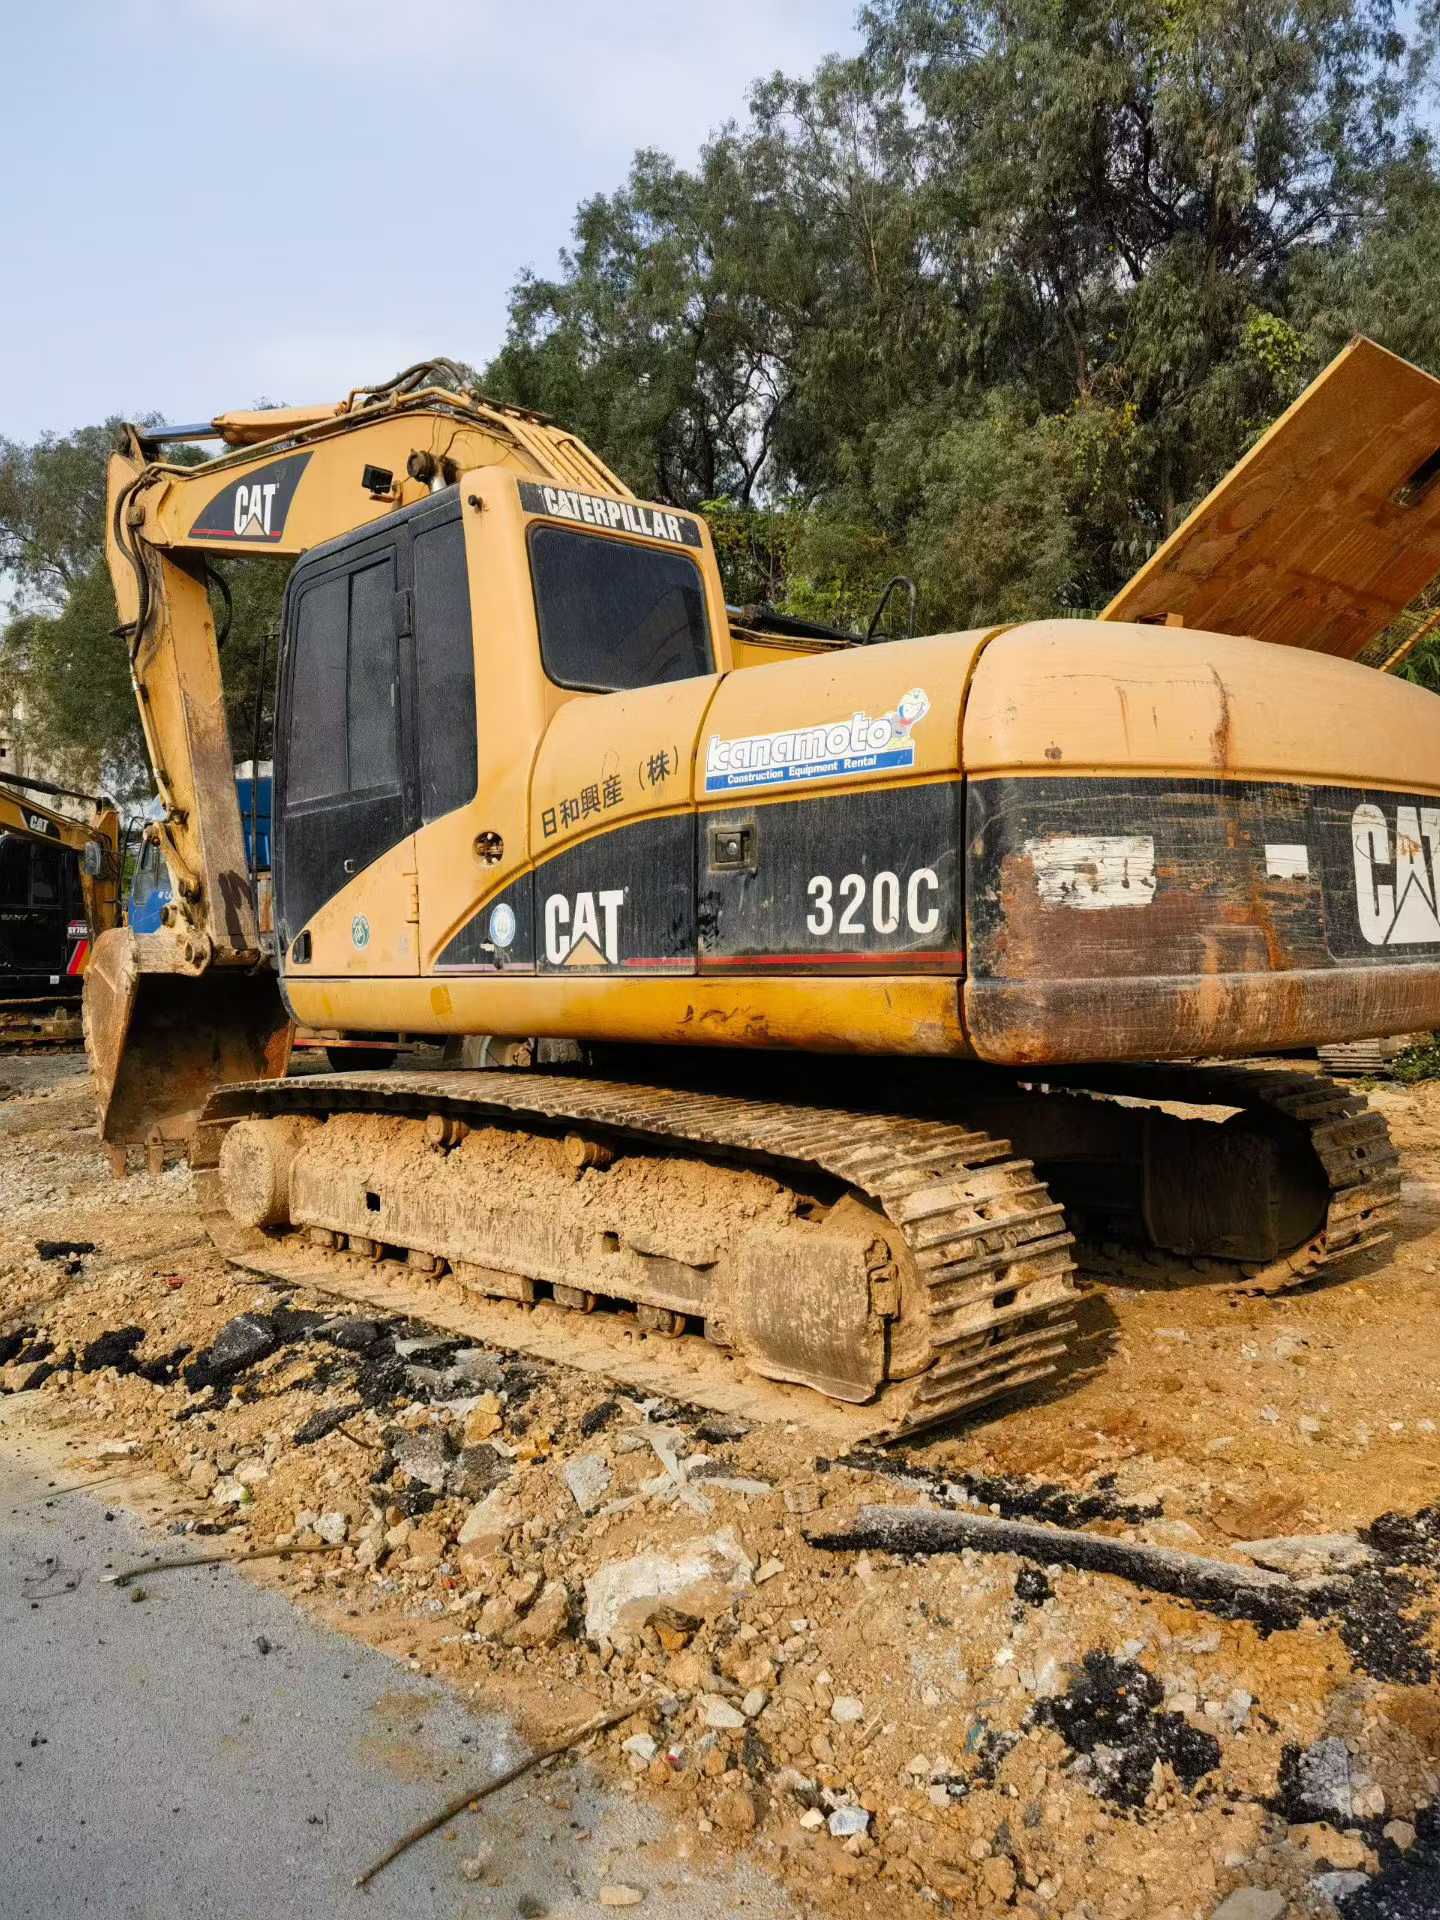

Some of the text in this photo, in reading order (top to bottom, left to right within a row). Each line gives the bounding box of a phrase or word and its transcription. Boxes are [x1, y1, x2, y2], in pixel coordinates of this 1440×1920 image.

[234, 483, 277, 536] CAT
[543, 487, 683, 542] CATERPILLAR
[707, 712, 893, 772] kanamoto
[727, 755, 877, 785] Construction Equipment Rental
[29, 815, 49, 833] CAT
[545, 889, 625, 966] CAT
[806, 868, 940, 936] 320C
